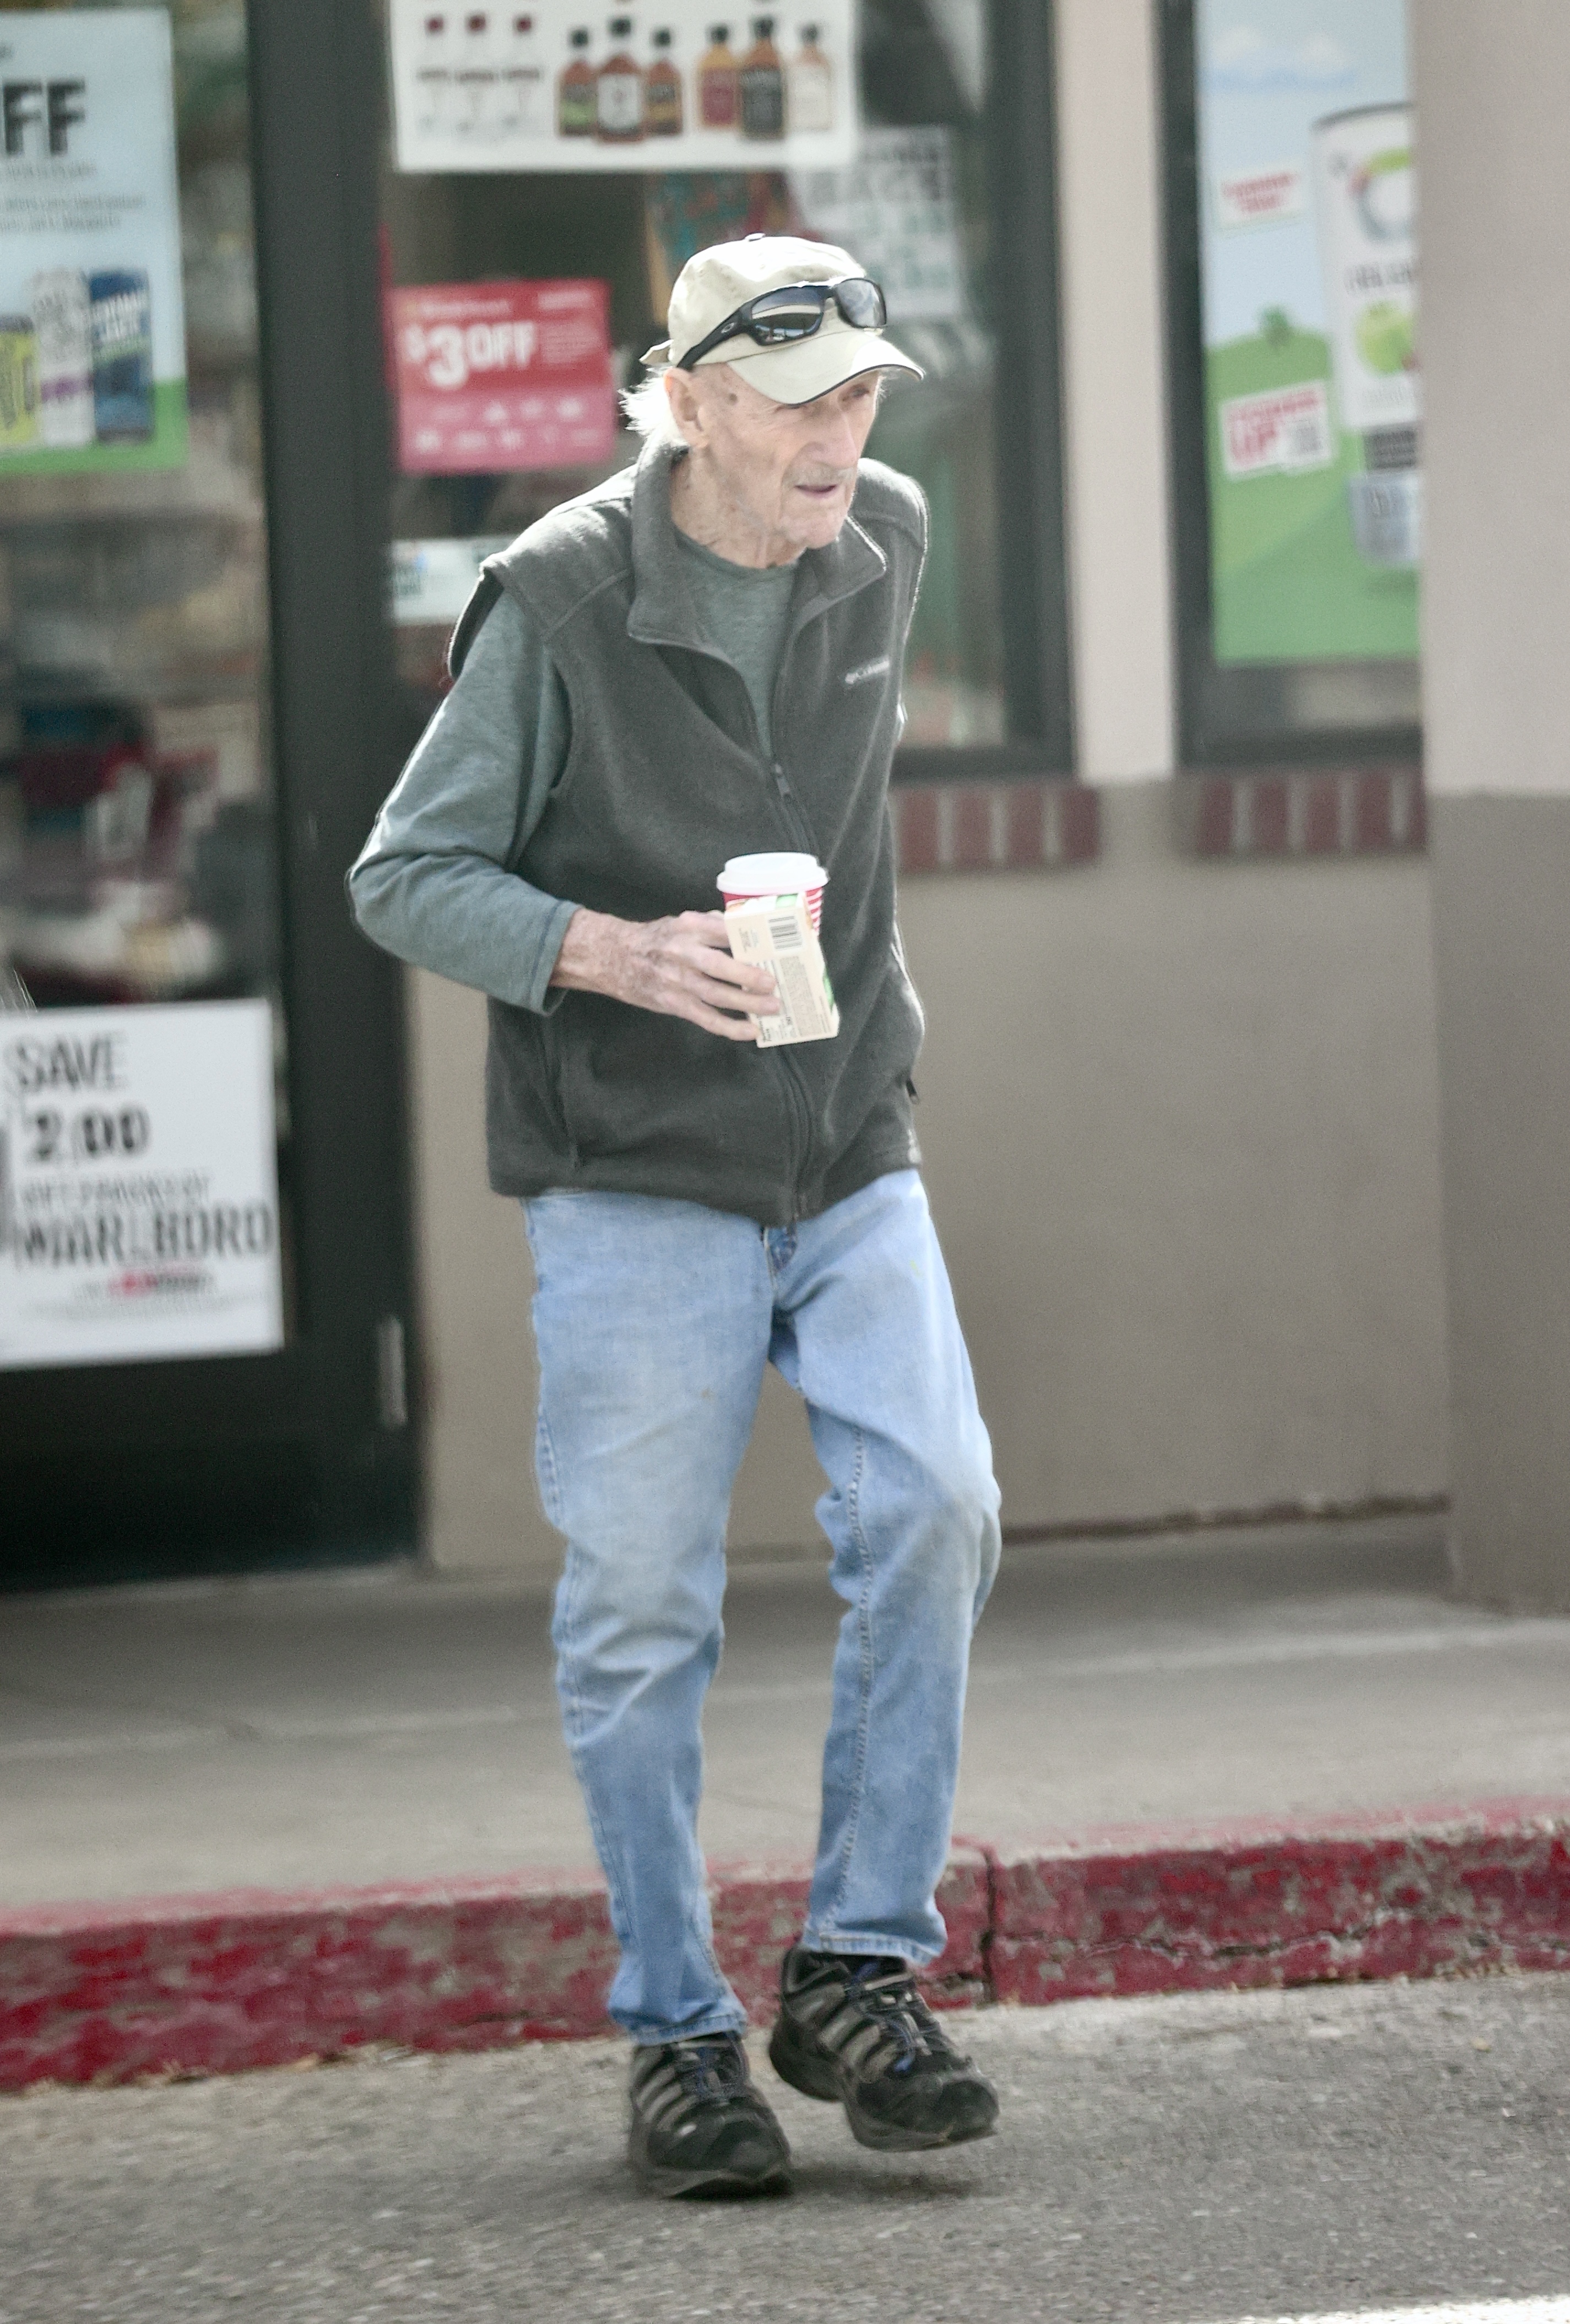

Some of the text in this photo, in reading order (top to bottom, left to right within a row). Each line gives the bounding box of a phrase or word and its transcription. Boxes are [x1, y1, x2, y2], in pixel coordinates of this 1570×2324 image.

[2, 78, 86, 156] FF
[469, 321, 535, 371] OFF
[9, 1031, 128, 1093] SAVE
[15, 1201, 273, 1266] MARLBORO
